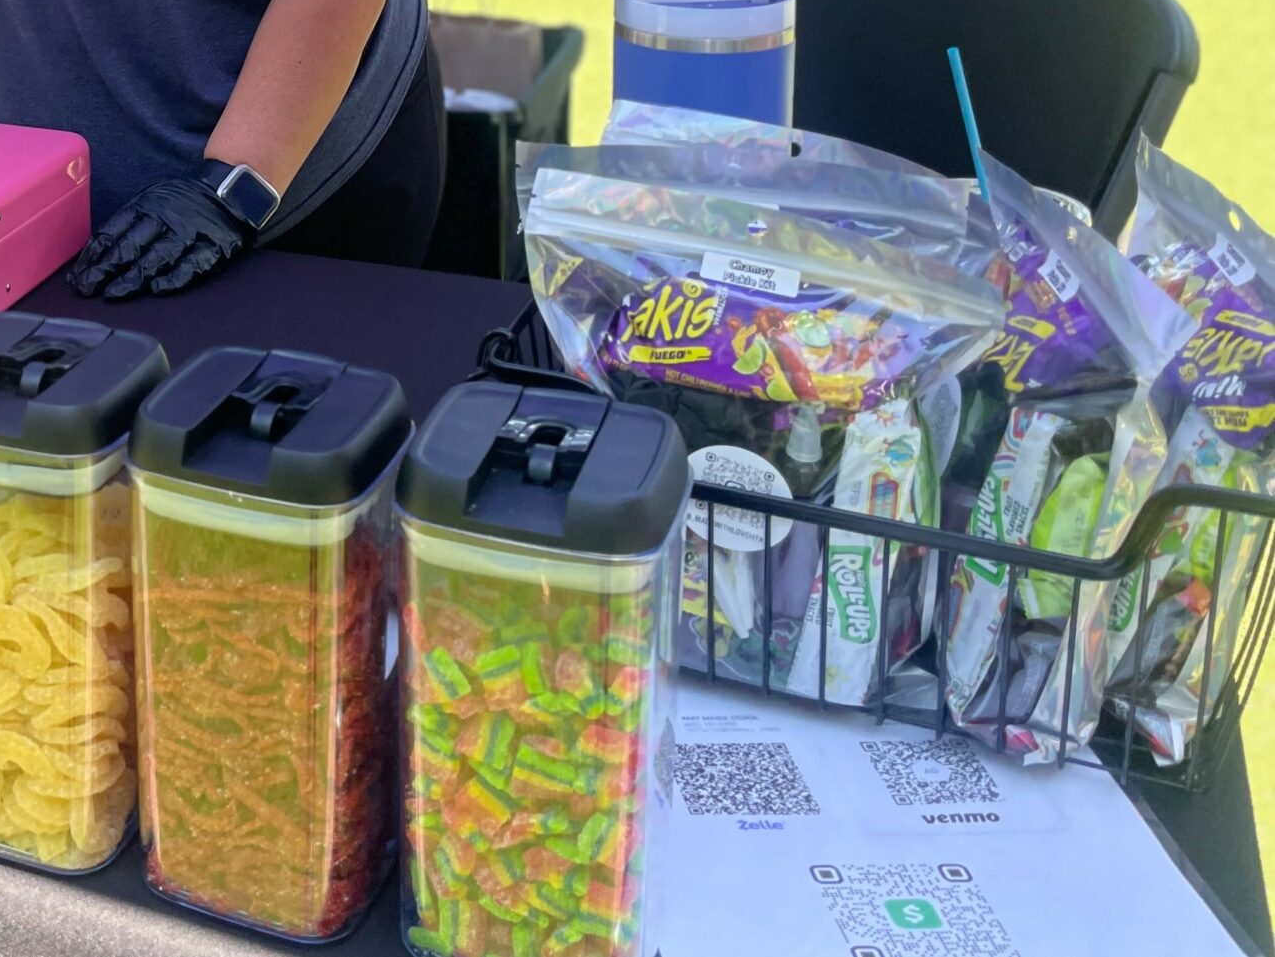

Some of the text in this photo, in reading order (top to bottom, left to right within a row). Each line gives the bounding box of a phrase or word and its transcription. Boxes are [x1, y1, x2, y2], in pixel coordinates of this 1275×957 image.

[729, 259, 775, 277] Chamoy
[723, 271, 757, 287] Pickle
[650, 349, 686, 360] FUEGO
[830, 553, 871, 640] ROLL-UPS
[736, 819, 783, 831] Zelle
[921, 811, 1000, 825] venmo
